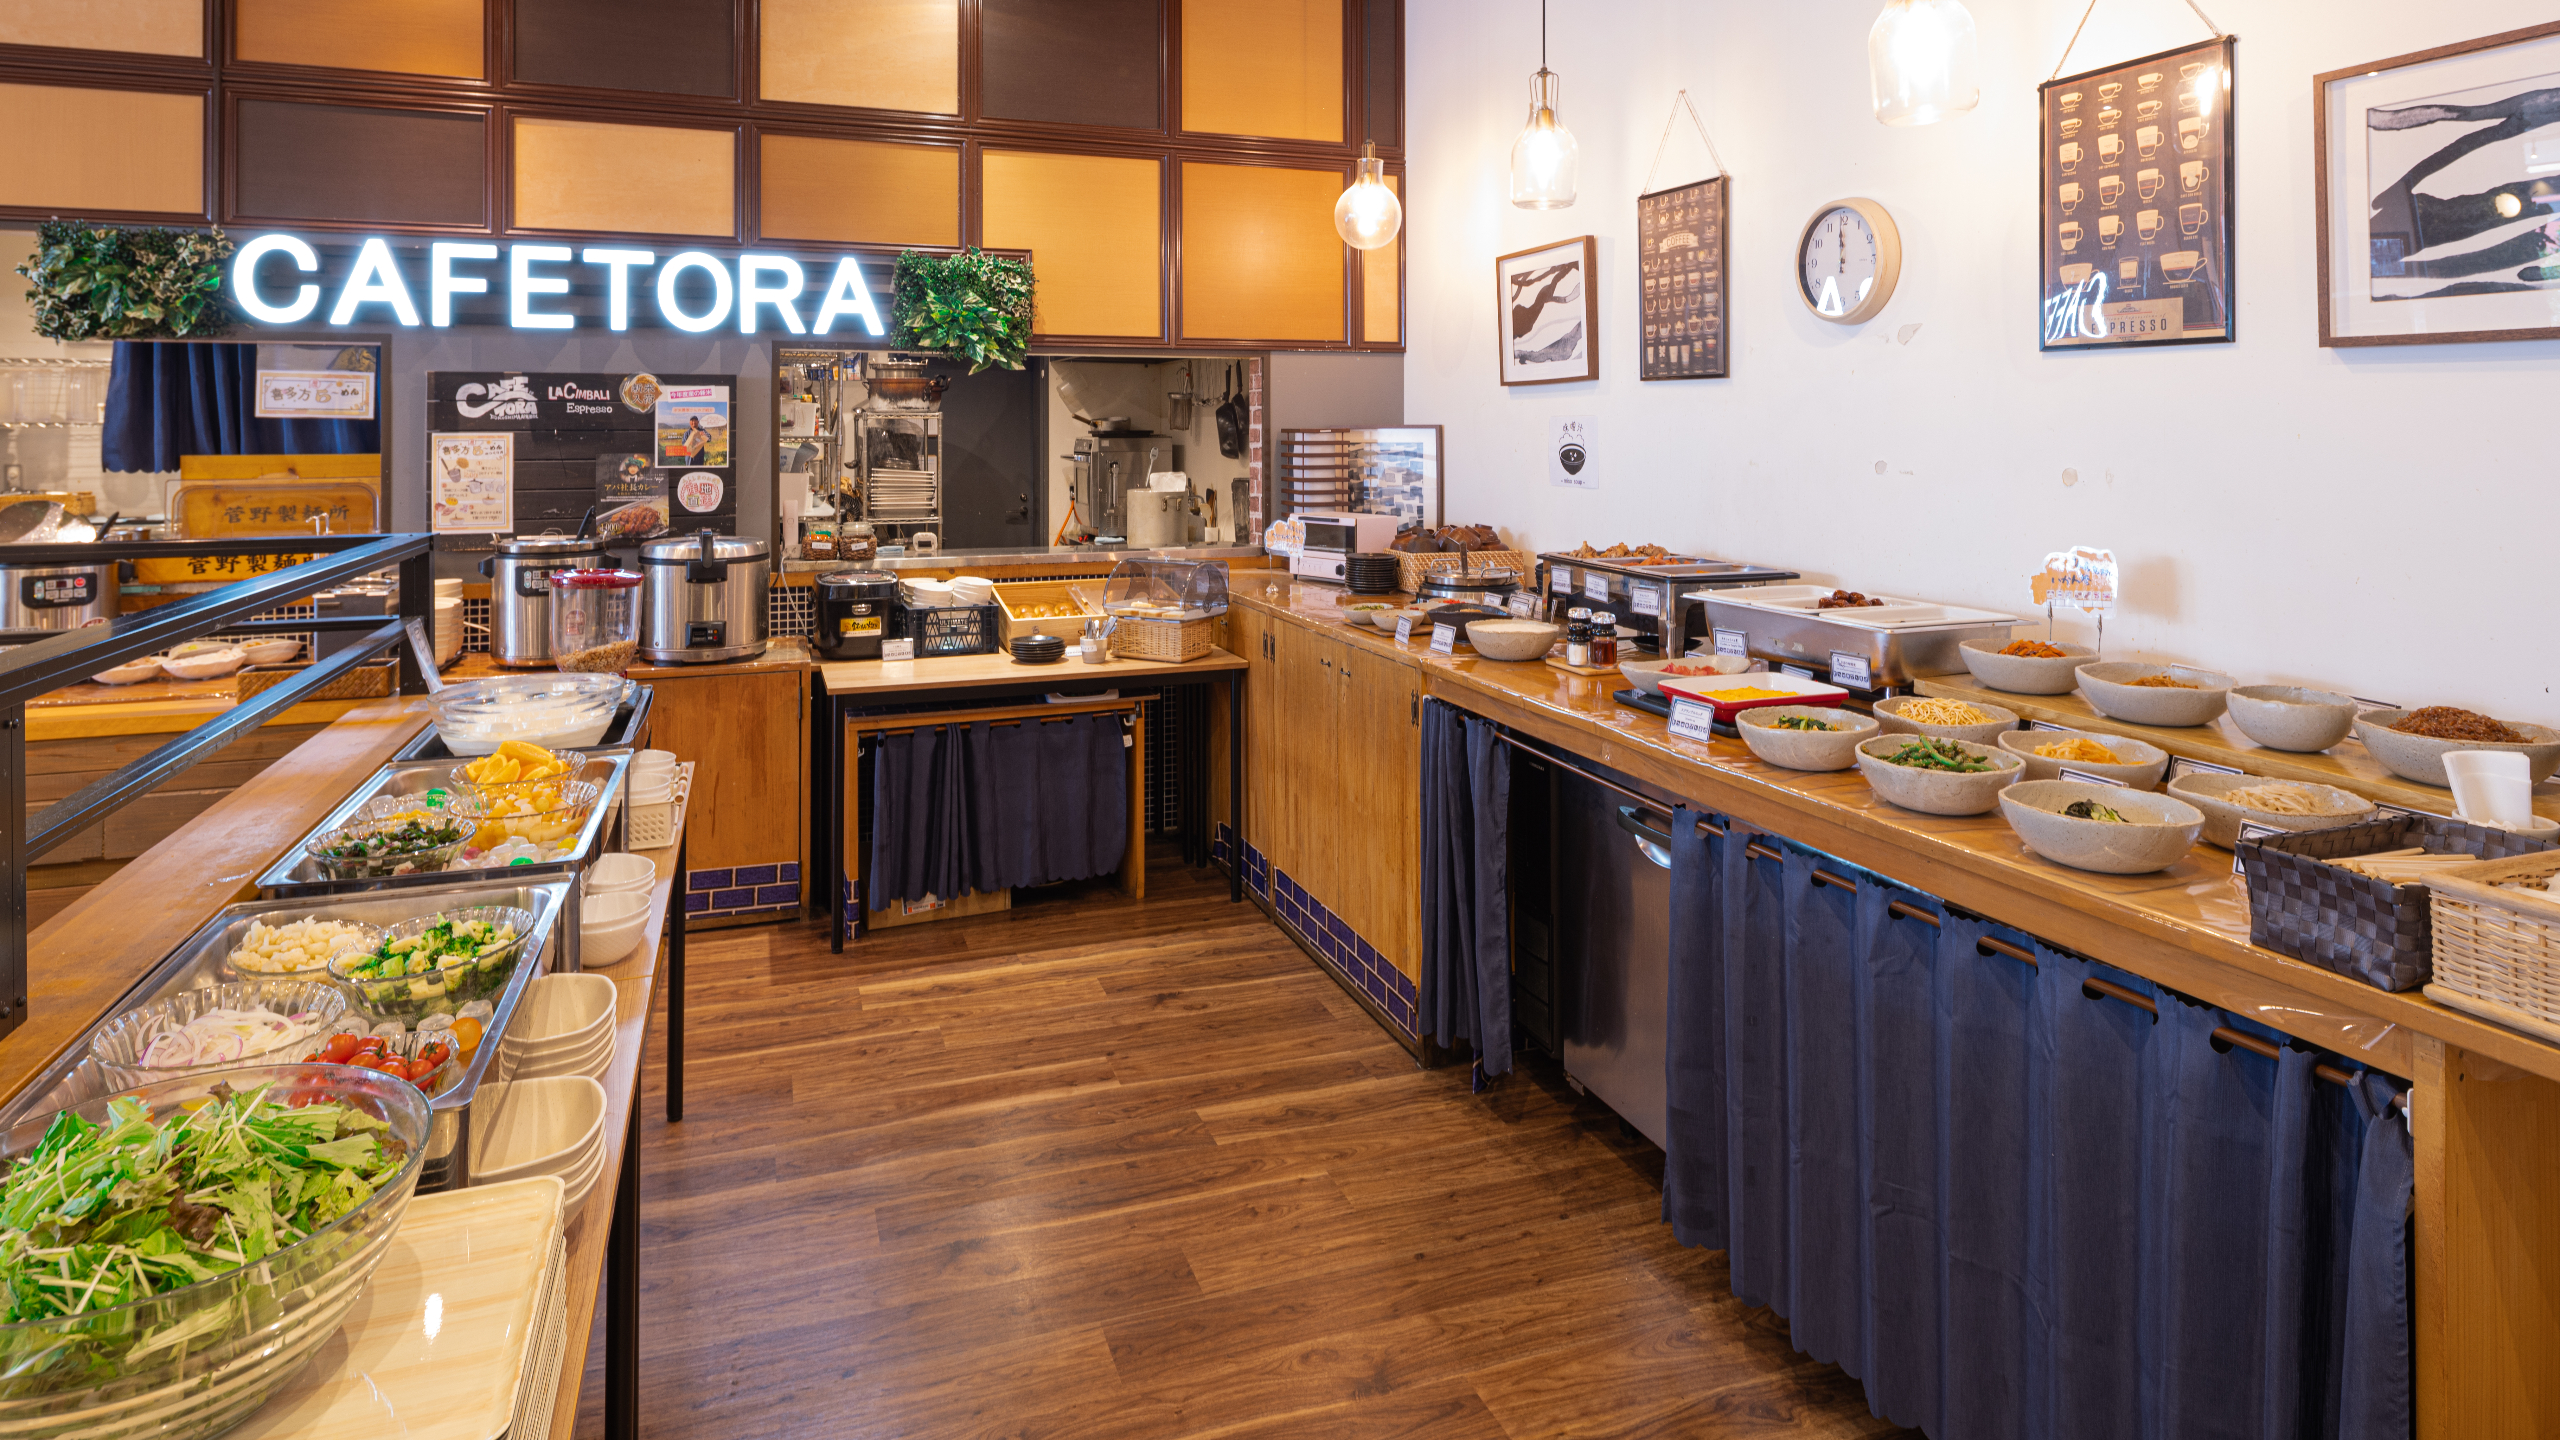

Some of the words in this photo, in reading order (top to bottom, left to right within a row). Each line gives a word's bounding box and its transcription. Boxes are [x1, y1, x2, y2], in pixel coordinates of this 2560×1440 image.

[1827, 223, 1833, 232] 11
[1666, 234, 1690, 247] COFFEE
[1815, 239, 1823, 249] 10
[1866, 233, 1873, 244] 2
[1811, 258, 1818, 268] 9
[232, 234, 885, 336] CAFETORA
[1814, 278, 1821, 288] 8
[1855, 290, 1861, 301] 5
[2091, 318, 2168, 335] EPRESSO
[631, 383, 656, 394] 新米
[456, 376, 538, 419] CAFE
[632, 393, 656, 405] 入荷
[493, 399, 538, 417] TORA
[566, 402, 613, 415] Espresso
[1563, 421, 1584, 433] 味噌汁
[604, 483, 659, 492] アパ社長カレー
[939, 618, 969, 626] ULTIMATE
